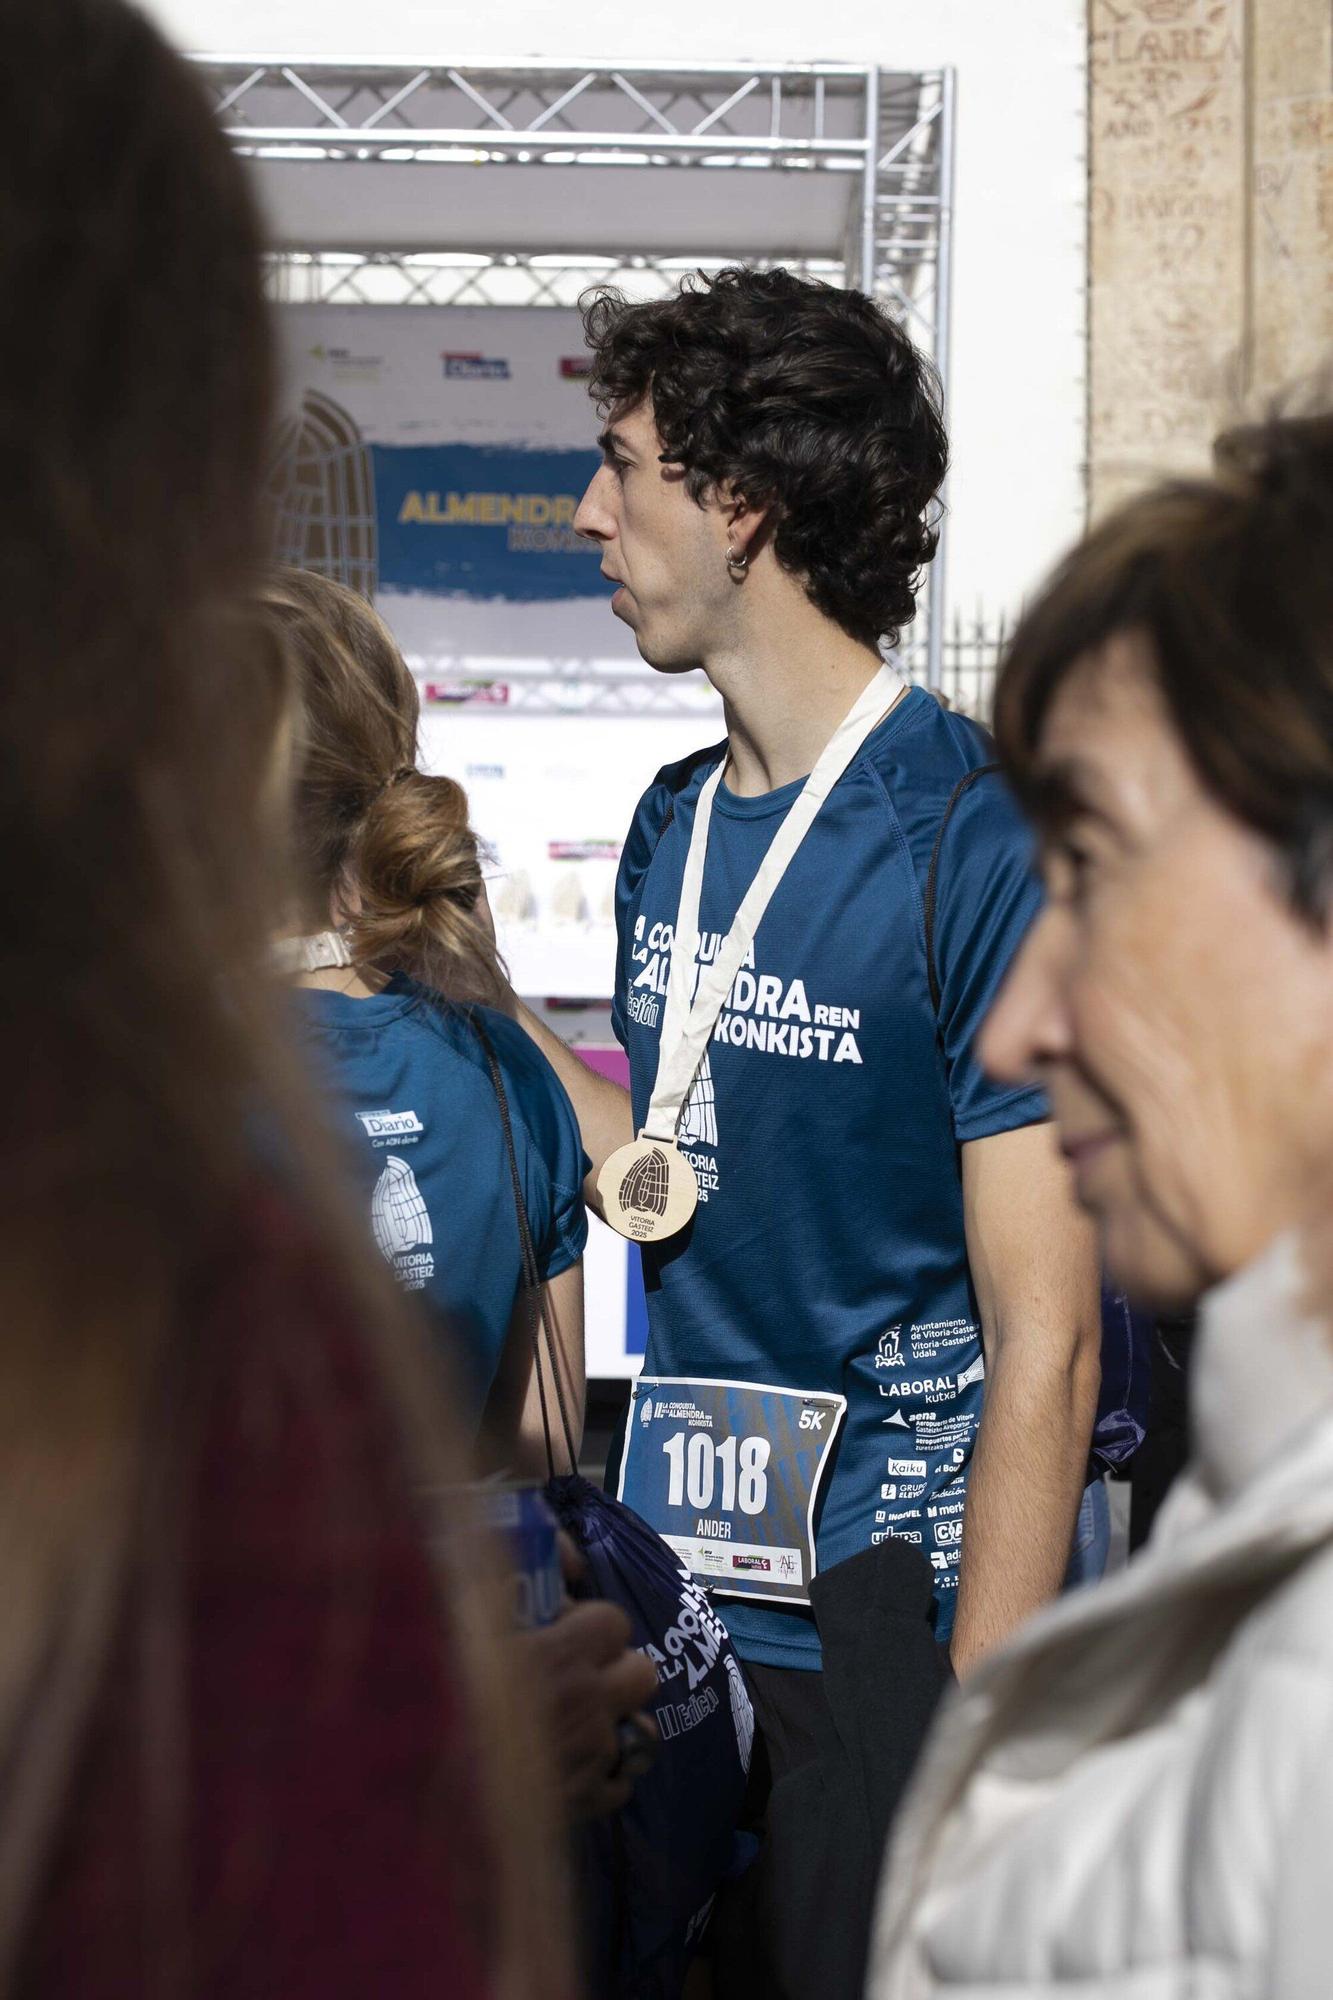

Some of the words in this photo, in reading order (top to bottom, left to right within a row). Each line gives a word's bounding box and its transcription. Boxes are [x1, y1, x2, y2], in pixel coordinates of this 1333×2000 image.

[398, 490, 578, 524] ALMENDR
[633, 953, 811, 1023] ALDRA
[814, 1004, 860, 1029] REN
[714, 1012, 863, 1064] KONKISTA
[369, 1115, 414, 1132] Diario
[681, 1150, 719, 1173] TORIA
[695, 1171, 720, 1190] TEIZ
[697, 1188, 709, 1203] 25
[628, 1222, 655, 1233] GASTEIZ
[630, 1215, 656, 1226] VITORIA
[631, 1229, 648, 1239] 2025
[393, 1252, 434, 1268] VITORIA
[910, 1318, 967, 1333] Ayuntamiento
[911, 1331, 921, 1341] de
[923, 1324, 980, 1339] Vitoria-Gaste
[912, 1349, 937, 1359] Udala
[879, 1376, 956, 1397] LABORAL
[925, 1390, 956, 1404] kutxa
[668, 1409, 705, 1420] ALMENDRA
[798, 1411, 827, 1431] 5K
[909, 1412, 937, 1422] aena
[663, 1432, 771, 1515] 1018
[891, 1462, 923, 1475] Kaiku
[938, 1501, 965, 1516] merk
[696, 1518, 731, 1539] ANDER
[737, 1556, 762, 1565] LABORAL
